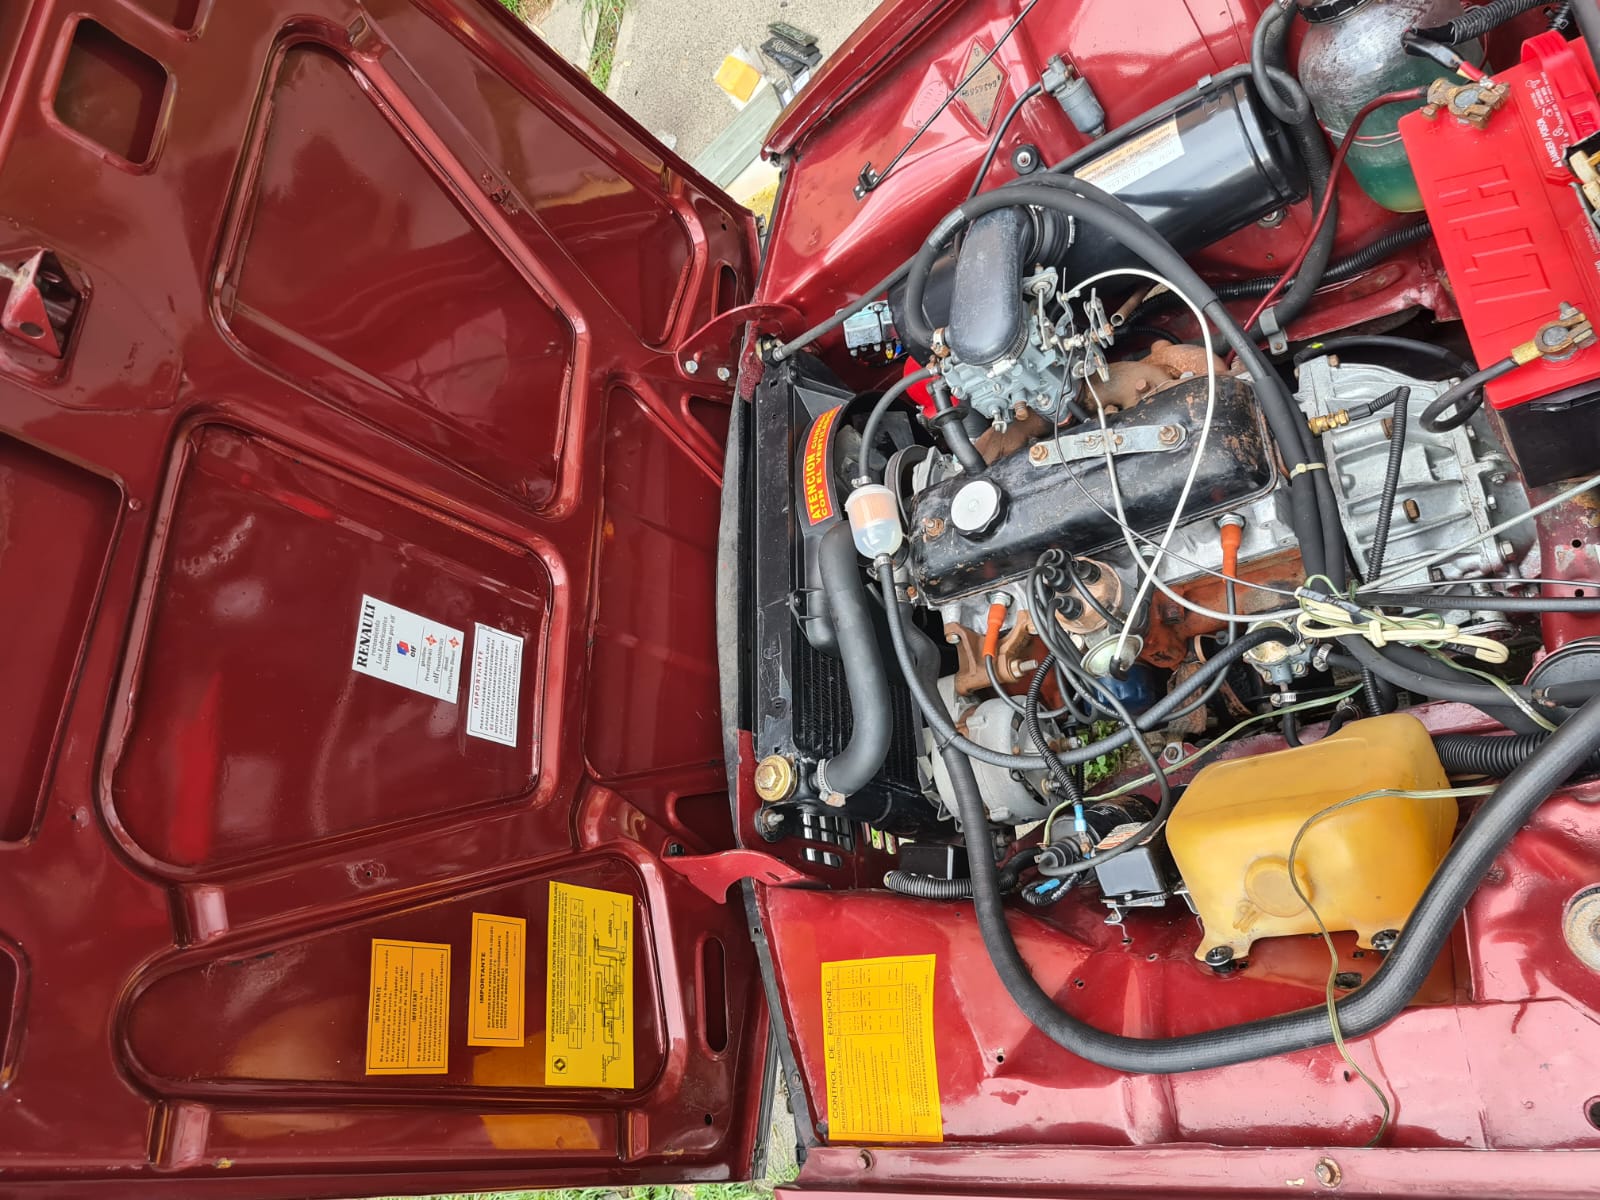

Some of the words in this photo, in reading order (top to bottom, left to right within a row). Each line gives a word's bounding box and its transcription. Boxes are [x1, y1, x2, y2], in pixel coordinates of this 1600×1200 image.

[1434, 164, 1552, 304] LTH
[806, 453, 821, 519] ATENCION
[816, 469, 823, 484] EL
[819, 489, 829, 517] CON
[357, 601, 376, 668] RENAULT
[474, 650, 484, 710] IMPORTANTE
[826, 980, 834, 1036] EMISIONES
[829, 1046, 835, 1060] DE
[831, 1069, 840, 1119] CONTROL
